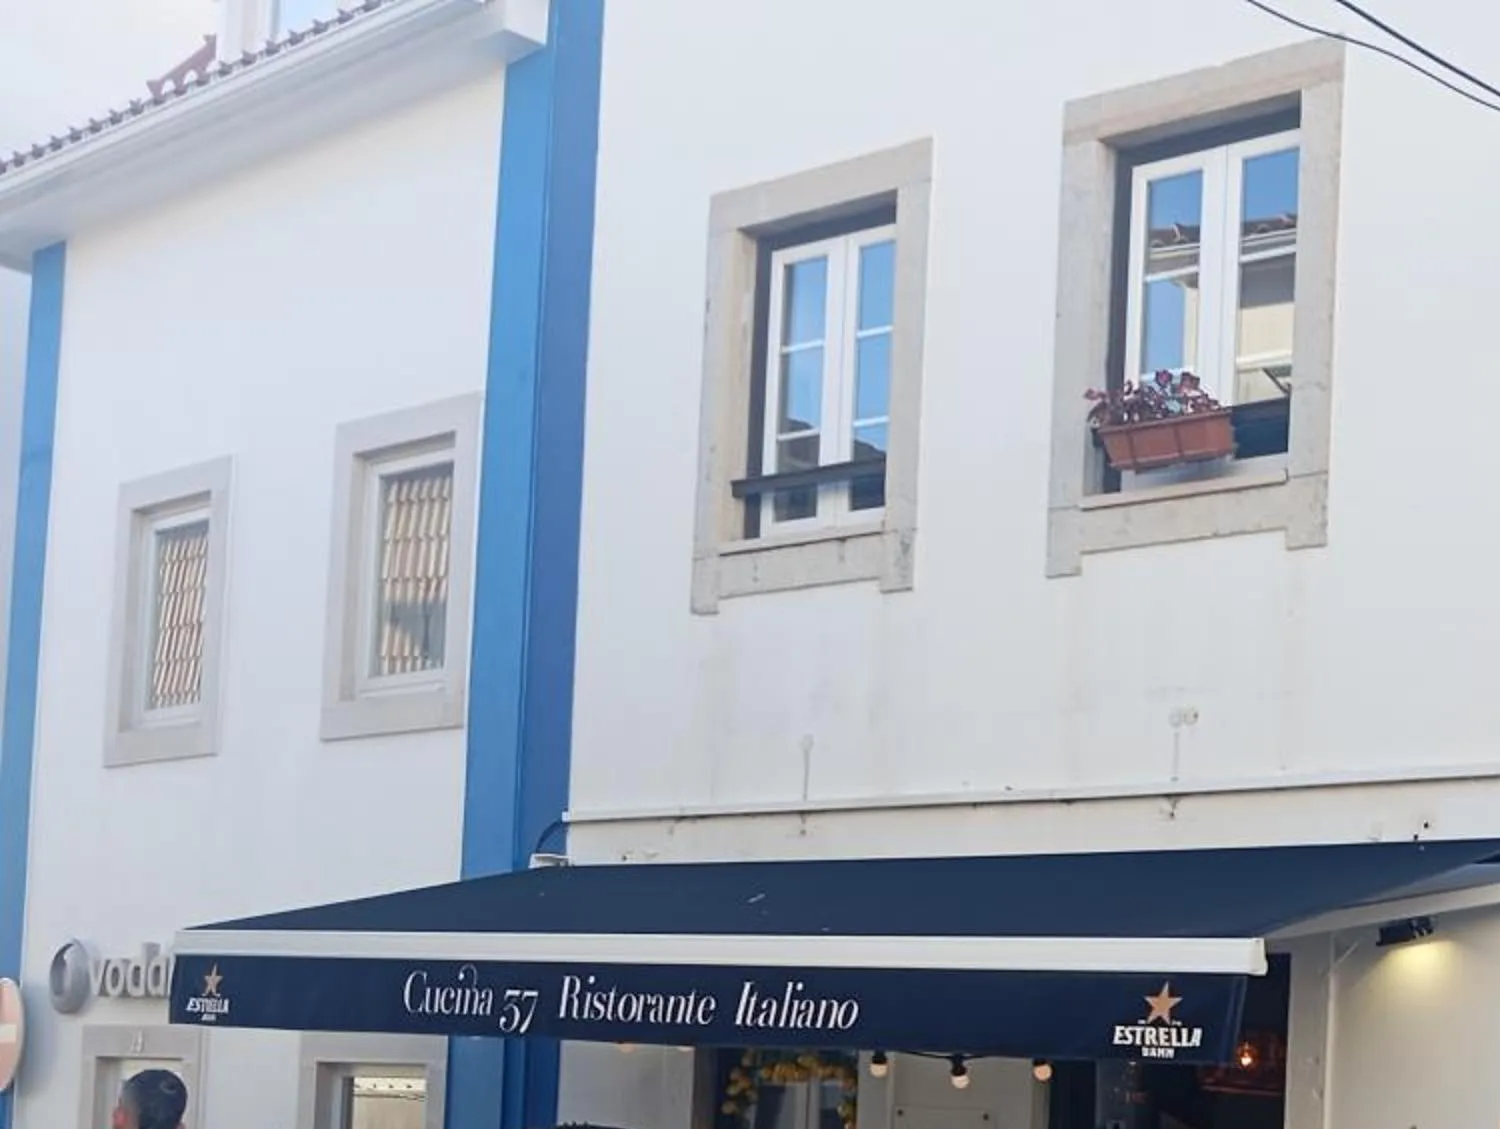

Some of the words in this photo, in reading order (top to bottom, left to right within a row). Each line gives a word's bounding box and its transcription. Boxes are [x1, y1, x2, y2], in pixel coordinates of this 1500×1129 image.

[89, 941, 170, 997] voda
[403, 963, 494, 1016] Cucina
[499, 989, 539, 1034] 57
[558, 974, 717, 1025] Ristorante
[735, 980, 860, 1030] Italiano
[1112, 1025, 1203, 1047] ESTRELLA
